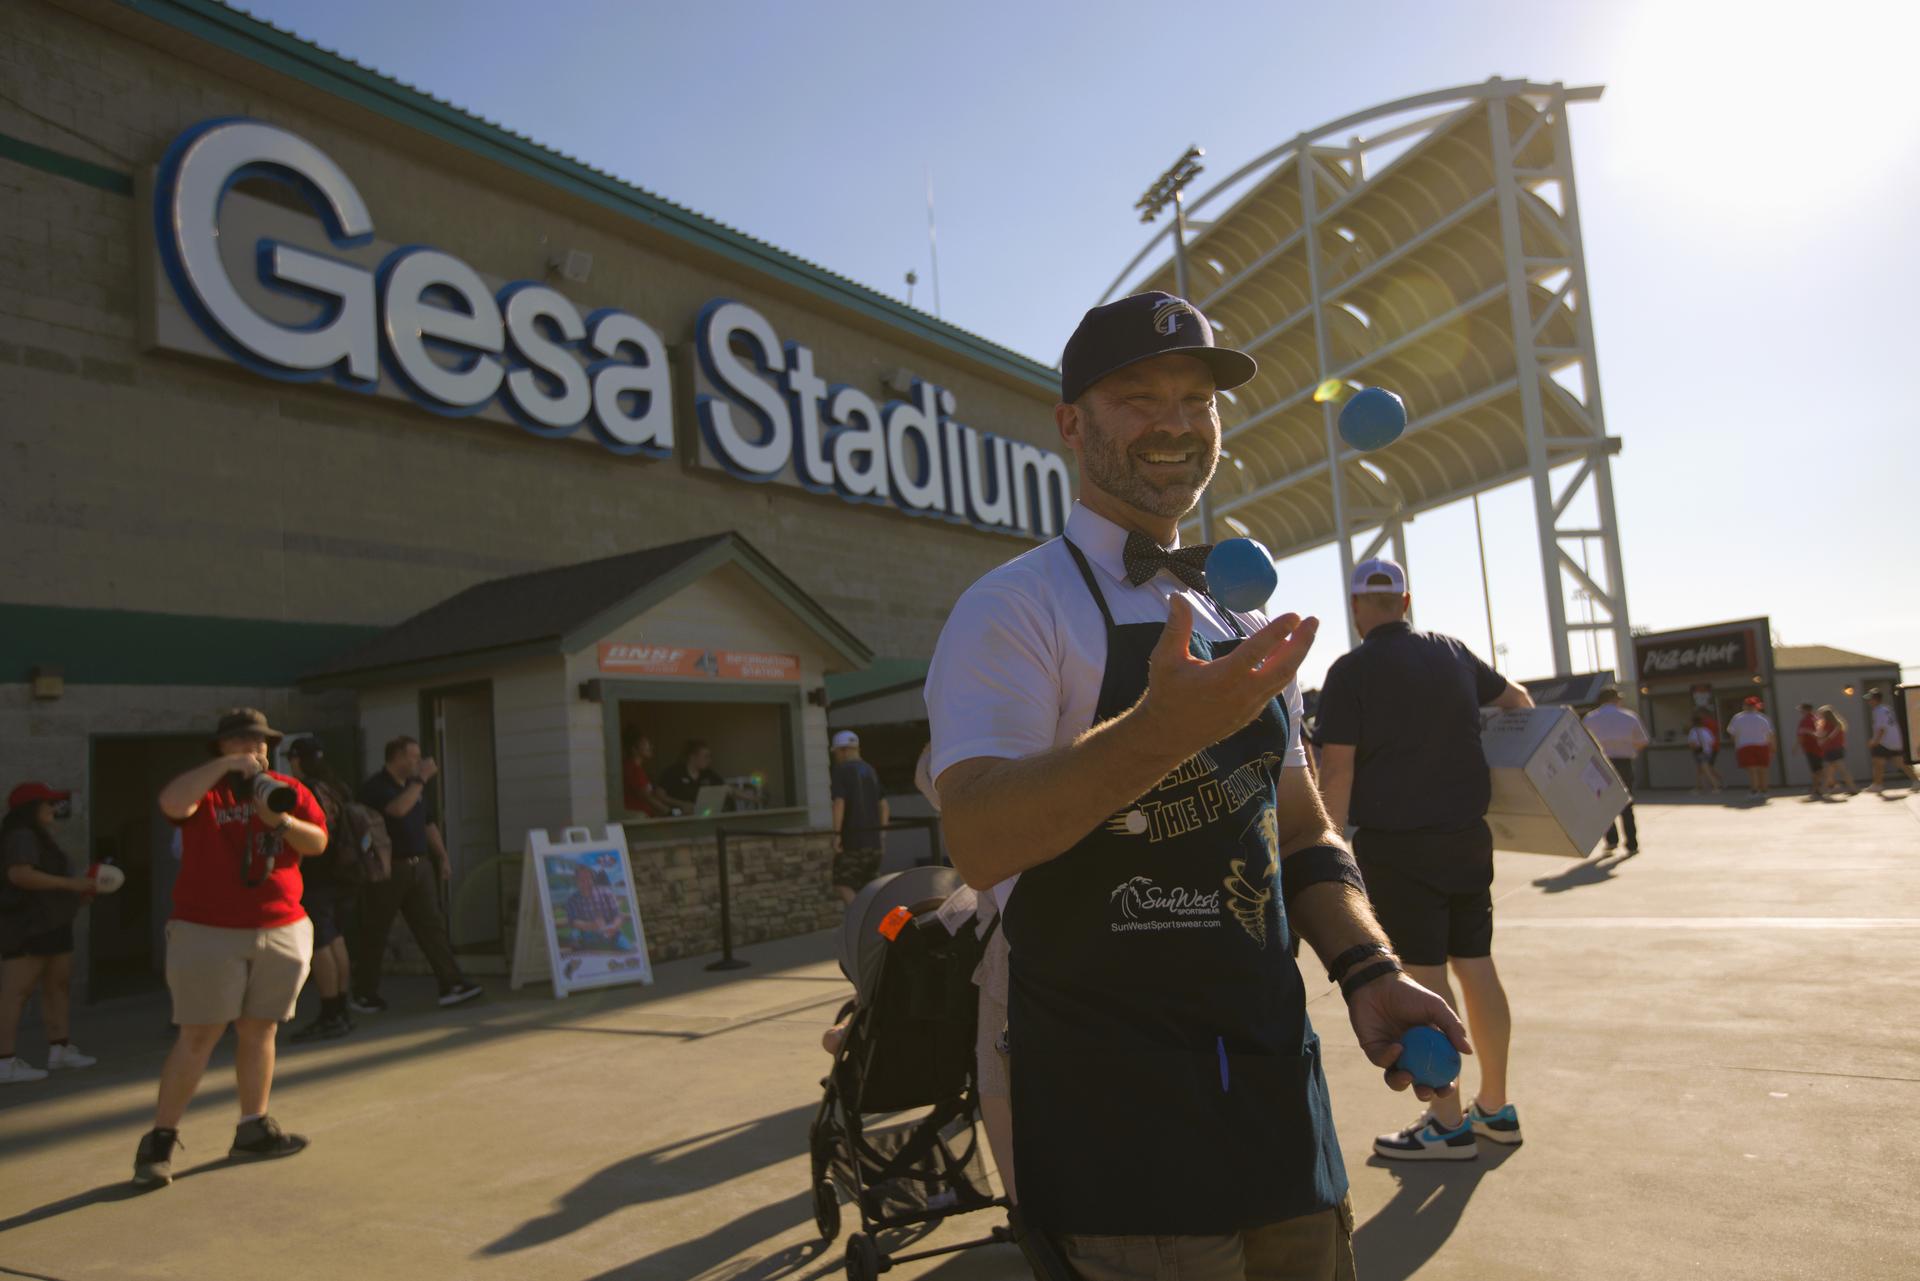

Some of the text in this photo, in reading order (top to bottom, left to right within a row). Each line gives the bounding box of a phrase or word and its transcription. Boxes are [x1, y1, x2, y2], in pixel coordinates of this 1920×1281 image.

[156, 117, 1072, 537] Gesa Stadium
[1643, 642, 1740, 673] Pizza Hut
[1140, 796, 1202, 843] THE
[1142, 887, 1219, 913] SunWest
[1177, 907, 1220, 916] SPORTSWEAR
[1111, 919, 1221, 932] SunWestSportswear.com
